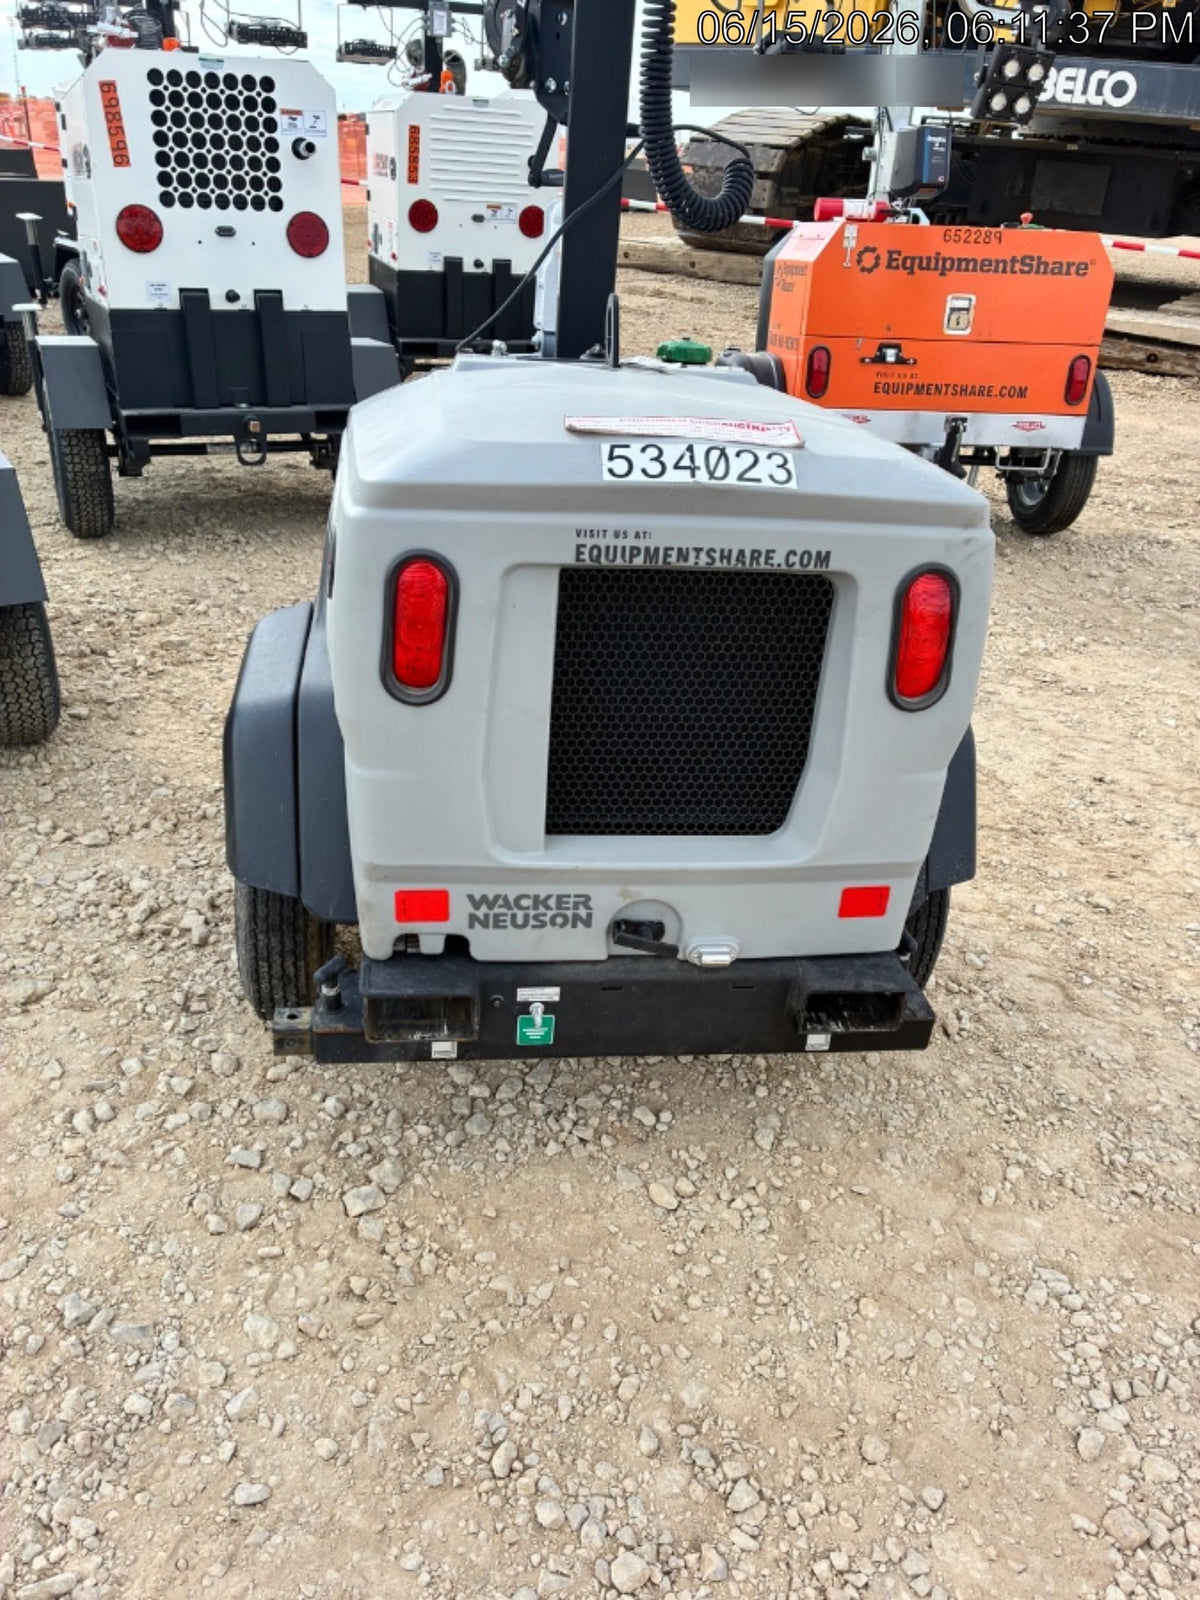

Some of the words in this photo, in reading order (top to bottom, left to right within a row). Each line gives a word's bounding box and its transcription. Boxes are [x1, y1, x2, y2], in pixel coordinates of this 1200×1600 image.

[100, 82, 130, 165] 698596
[943, 229, 1002, 245] 652289
[874, 381, 1028, 399] EQUIPMENTSHARE.COM
[606, 443, 794, 485] 534023
[575, 528, 608, 539] VISIT
[613, 529, 628, 540] US
[634, 530, 652, 540] AT:
[574, 543, 832, 569] EQUIPMENTSHARE.COM
[466, 893, 593, 911] WACKER
[467, 912, 593, 929] NEUSON
